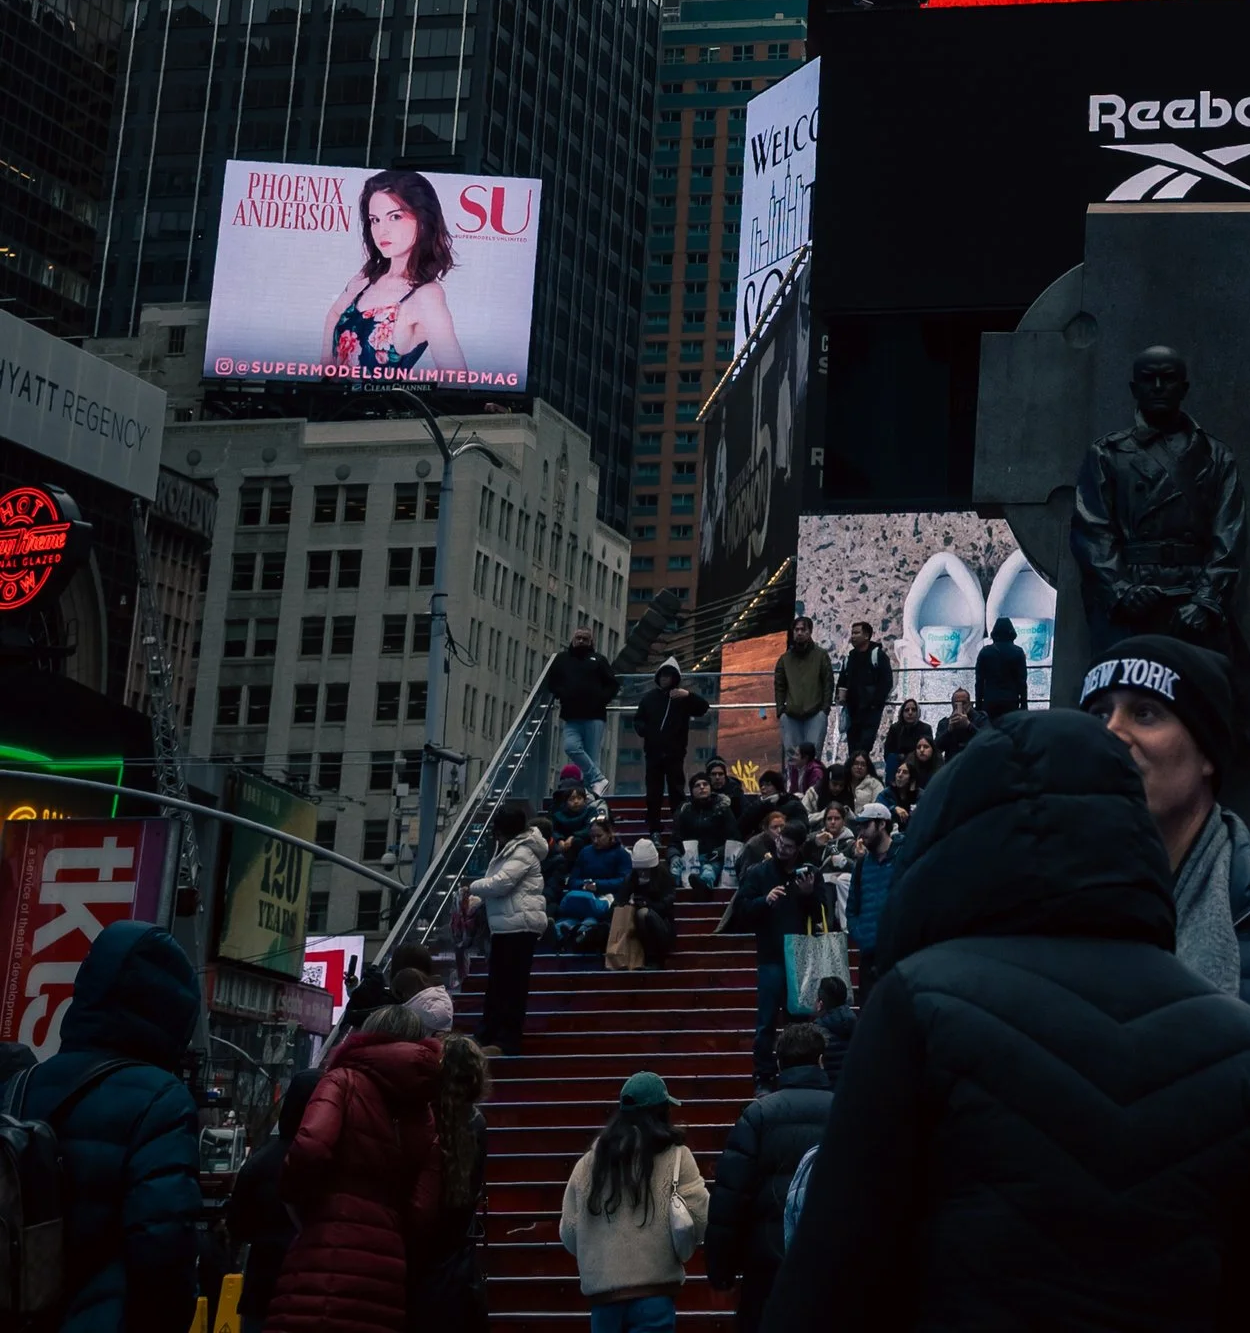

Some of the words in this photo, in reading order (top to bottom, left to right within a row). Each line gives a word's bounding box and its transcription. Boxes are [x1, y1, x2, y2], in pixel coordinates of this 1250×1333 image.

[247, 171, 345, 205] PHOENIX
[232, 198, 352, 233] ANDERSON
[455, 184, 533, 236] SU
[235, 360, 519, 386] @SUPERMODELSUNLIMITEDMAG
[62, 390, 148, 451] REGENCY
[0, 496, 45, 523] HOT
[22, 553, 62, 566] GLAZED
[1079, 658, 1120, 706] NEW
[1118, 658, 1181, 701] YORK
[28, 848, 37, 856] a
[22, 858, 35, 900] service
[22, 902, 30, 917] of
[258, 899, 298, 936] YEARS
[16, 917, 29, 961] theatre
[3, 961, 25, 1039] development
